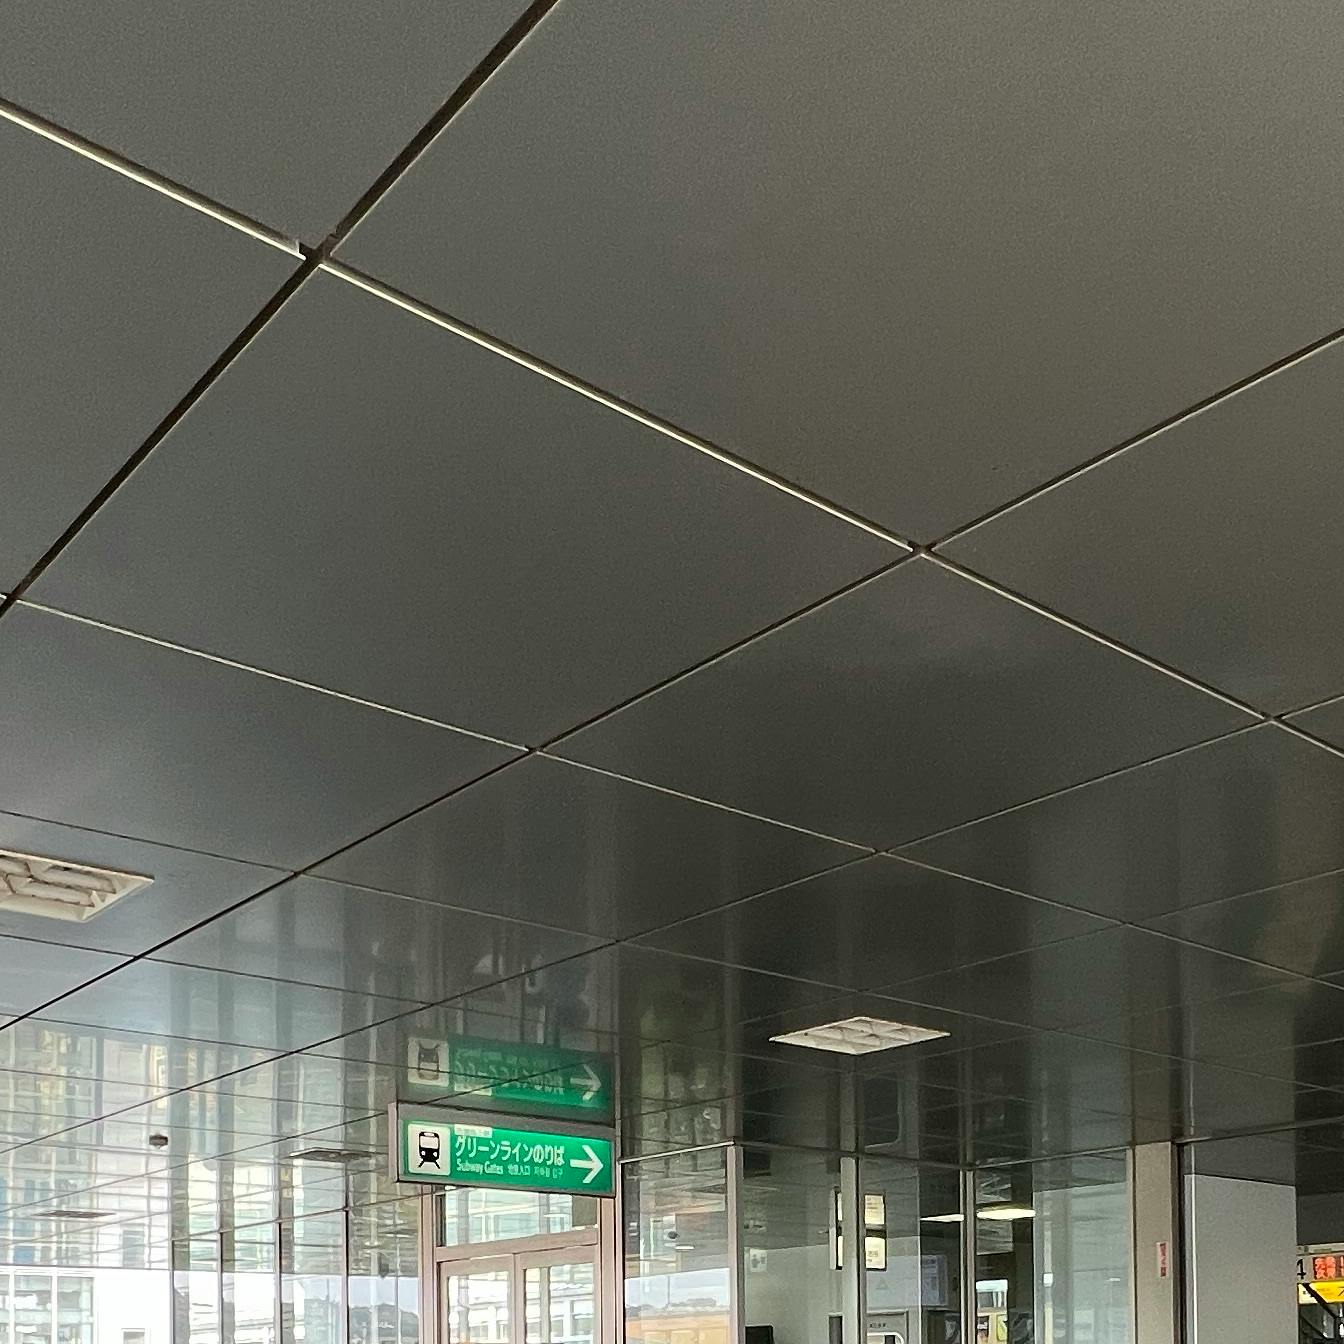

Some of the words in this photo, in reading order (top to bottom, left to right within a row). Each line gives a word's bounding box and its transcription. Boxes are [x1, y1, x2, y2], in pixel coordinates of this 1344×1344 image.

[455, 1135, 565, 1166] グリーンラインのりば
